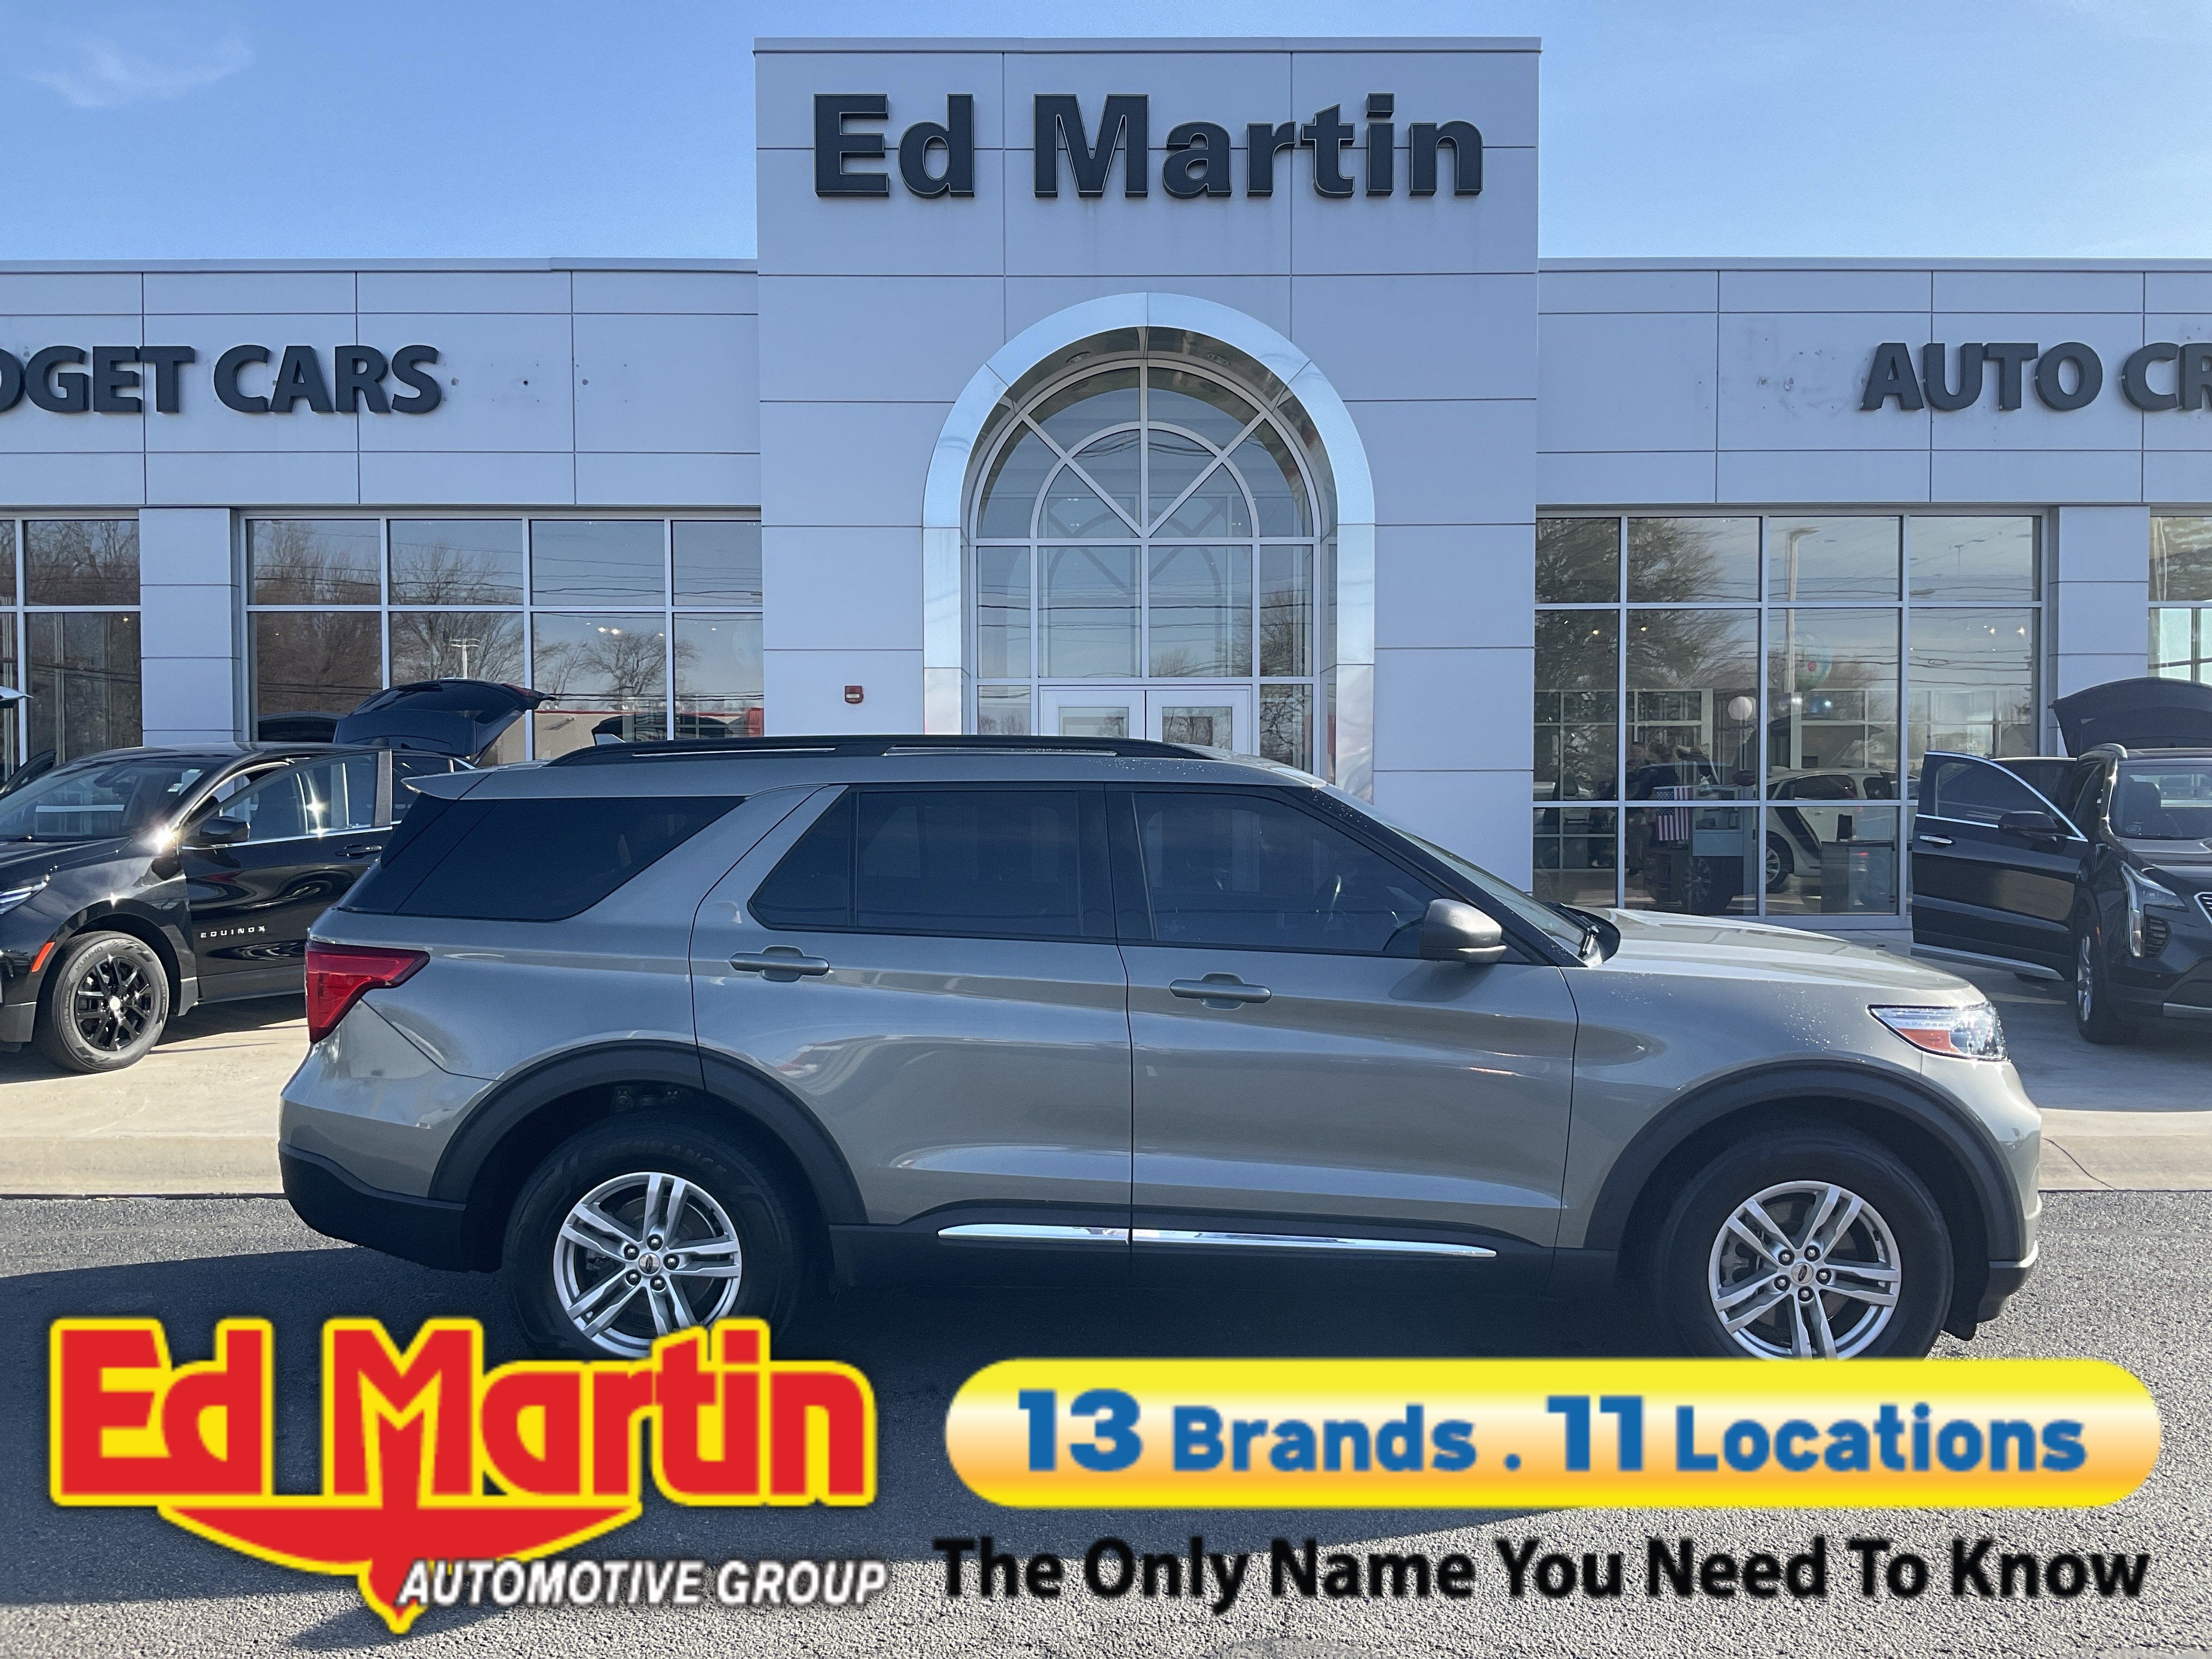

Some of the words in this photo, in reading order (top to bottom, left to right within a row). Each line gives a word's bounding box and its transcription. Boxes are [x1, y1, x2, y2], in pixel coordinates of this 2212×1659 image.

[814, 94, 975, 200] Ed
[1034, 93, 1483, 201] Martin
[213, 345, 443, 415] CARS
[1859, 342, 2103, 412] AUTO
[200, 926, 266, 938] EQUINOX
